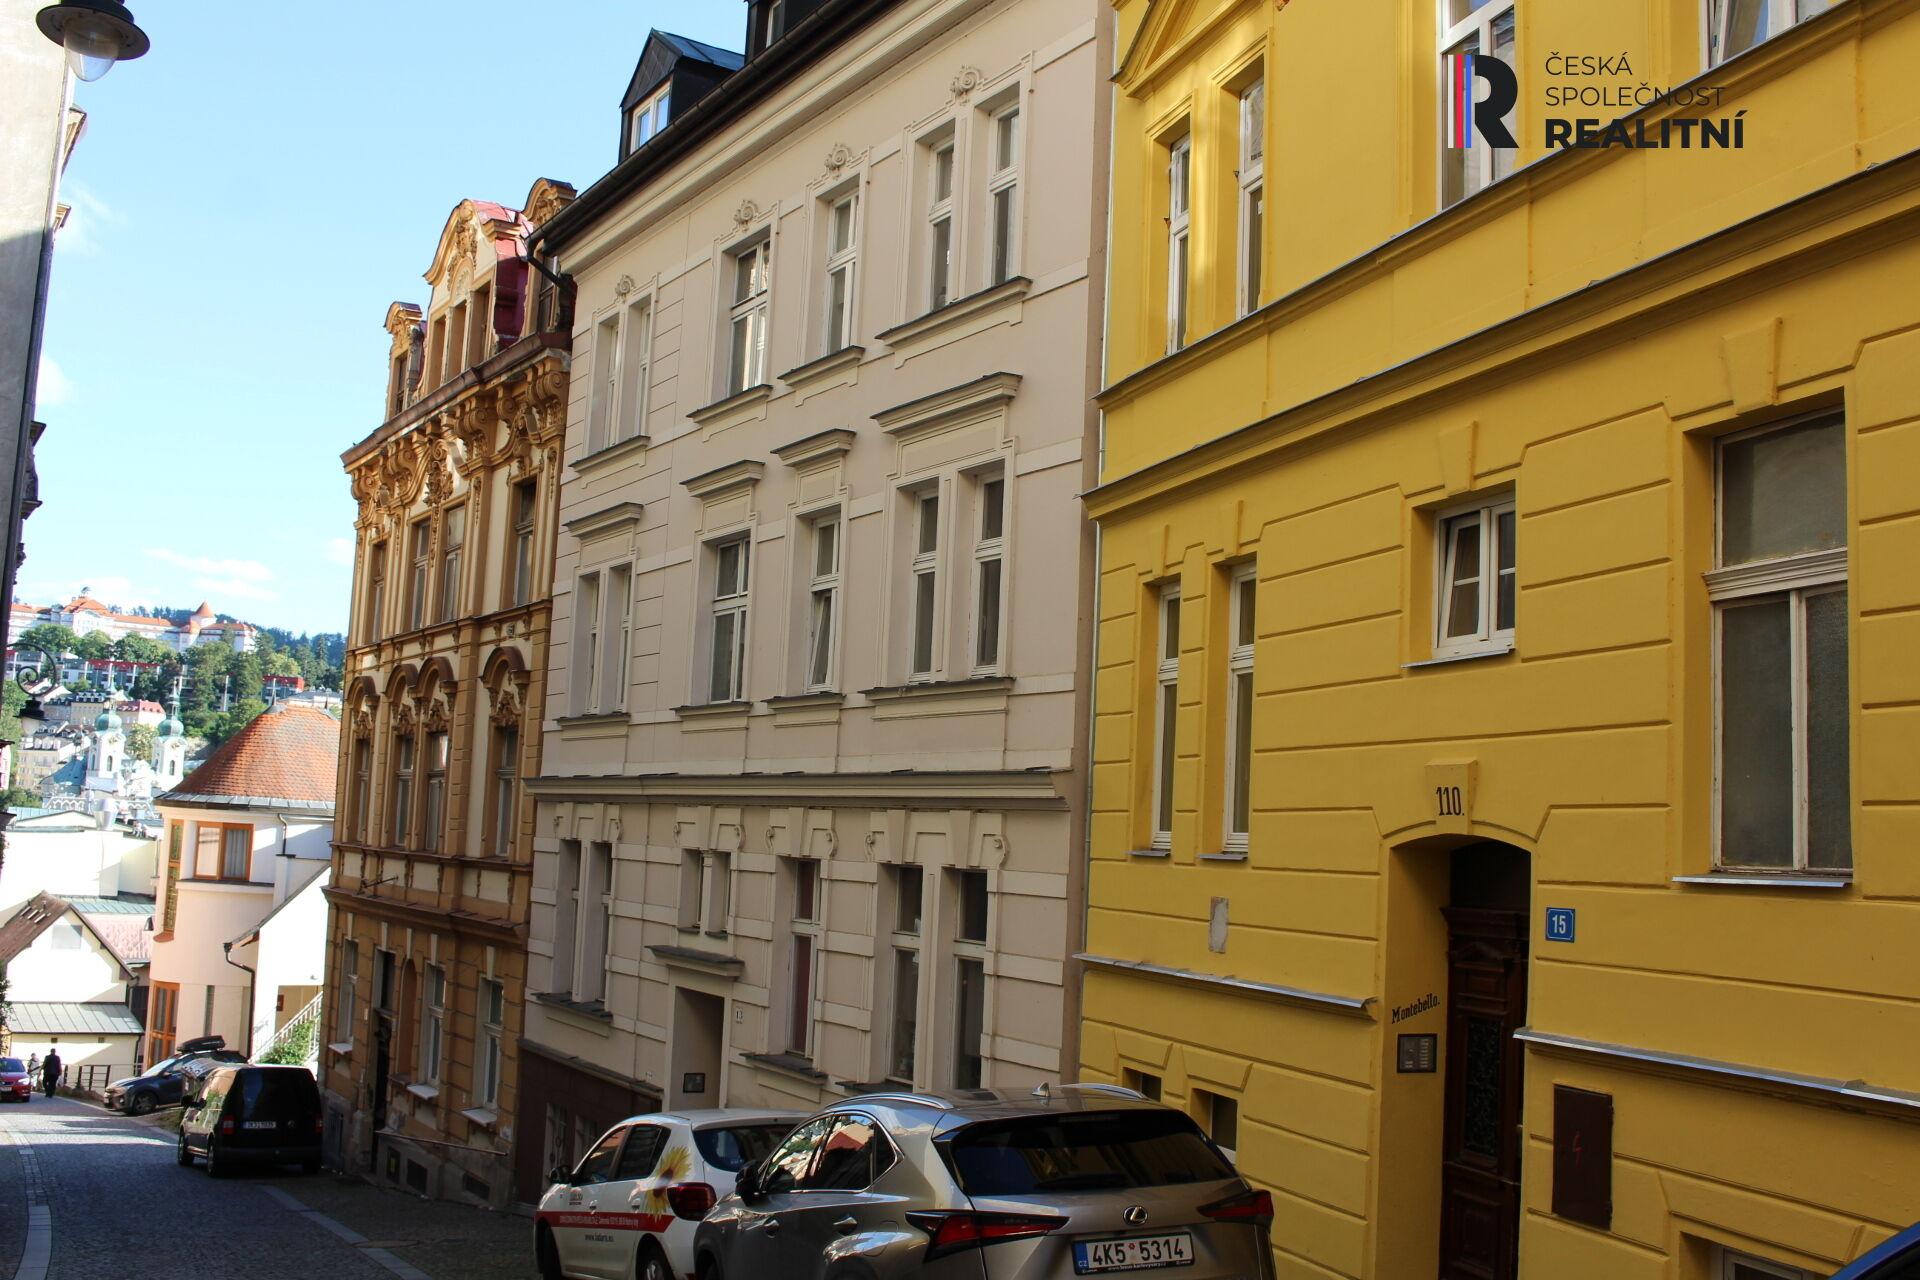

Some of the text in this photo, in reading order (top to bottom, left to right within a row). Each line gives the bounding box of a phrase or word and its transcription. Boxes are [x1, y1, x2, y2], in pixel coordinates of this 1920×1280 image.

[1552, 914, 1566, 935] 15
[1391, 992, 1441, 1025] Montebello.
[1092, 1238, 1184, 1266] 4K5 5314
